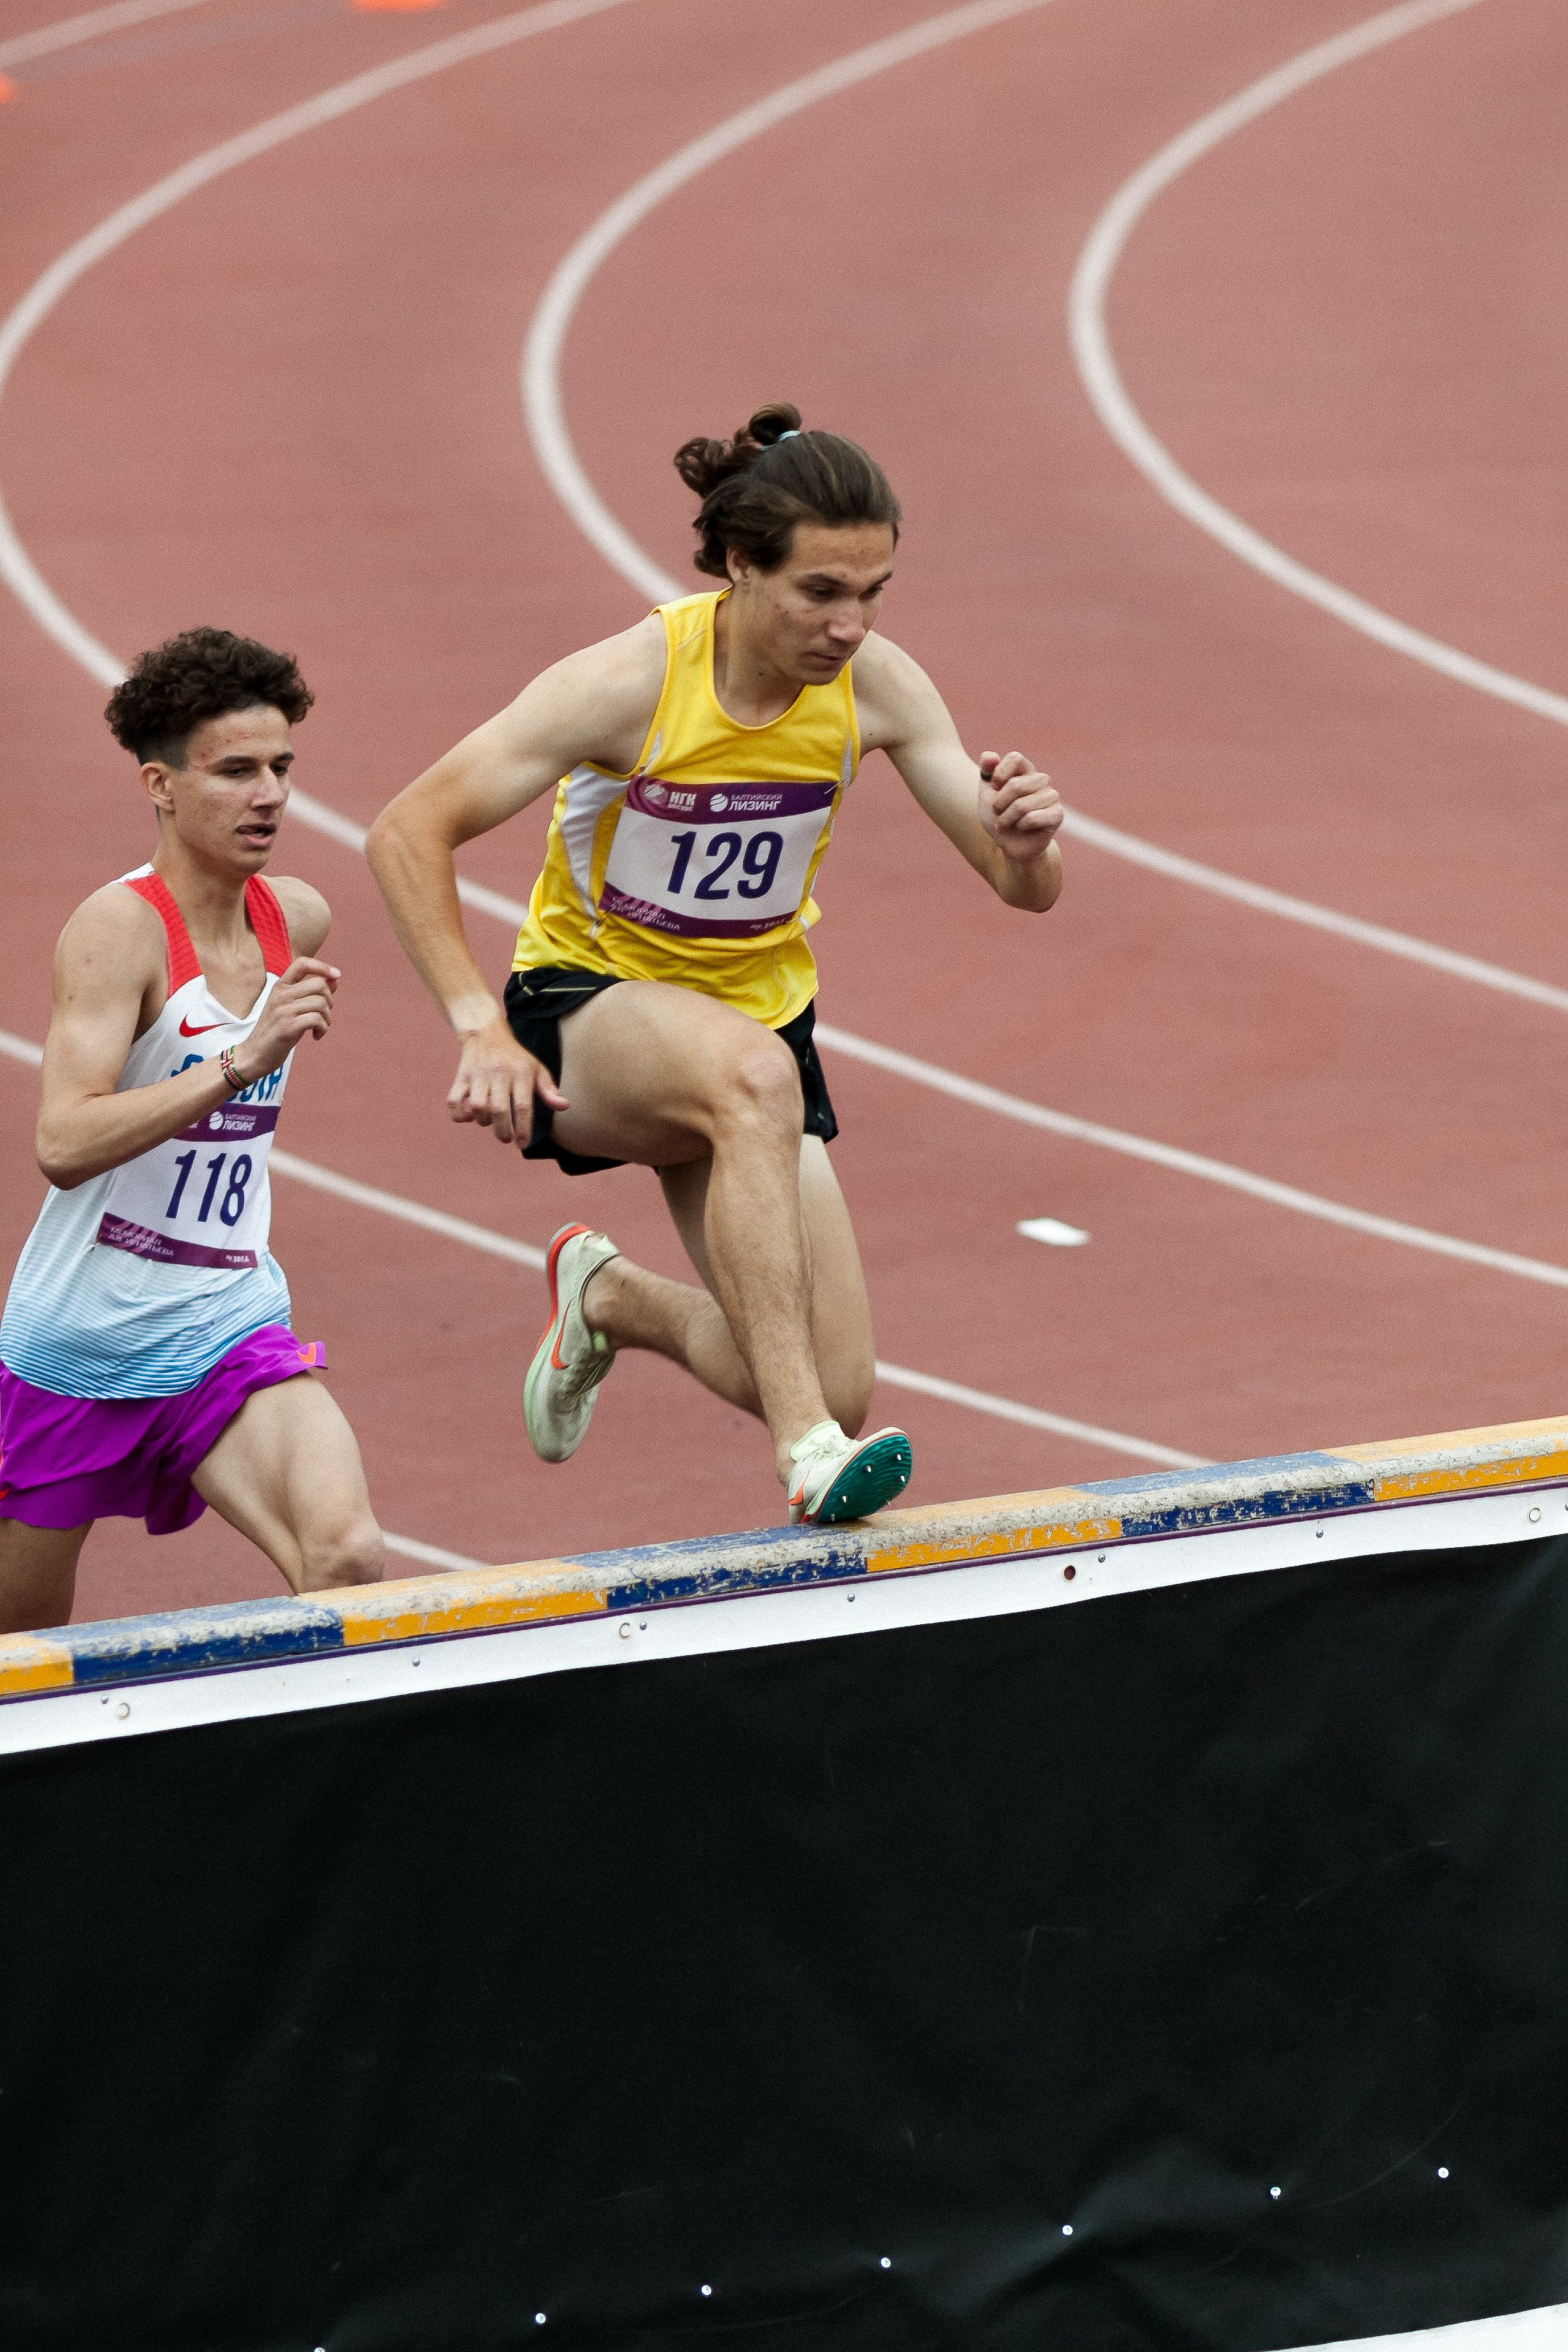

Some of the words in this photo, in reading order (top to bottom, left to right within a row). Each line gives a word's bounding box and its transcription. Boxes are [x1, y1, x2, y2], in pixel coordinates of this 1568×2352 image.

[728, 801, 781, 811] ЛИЗИНГ
[667, 831, 783, 899] 129
[222, 1120, 255, 1131] ЛИЗИНГ
[166, 1150, 252, 1226] 118
